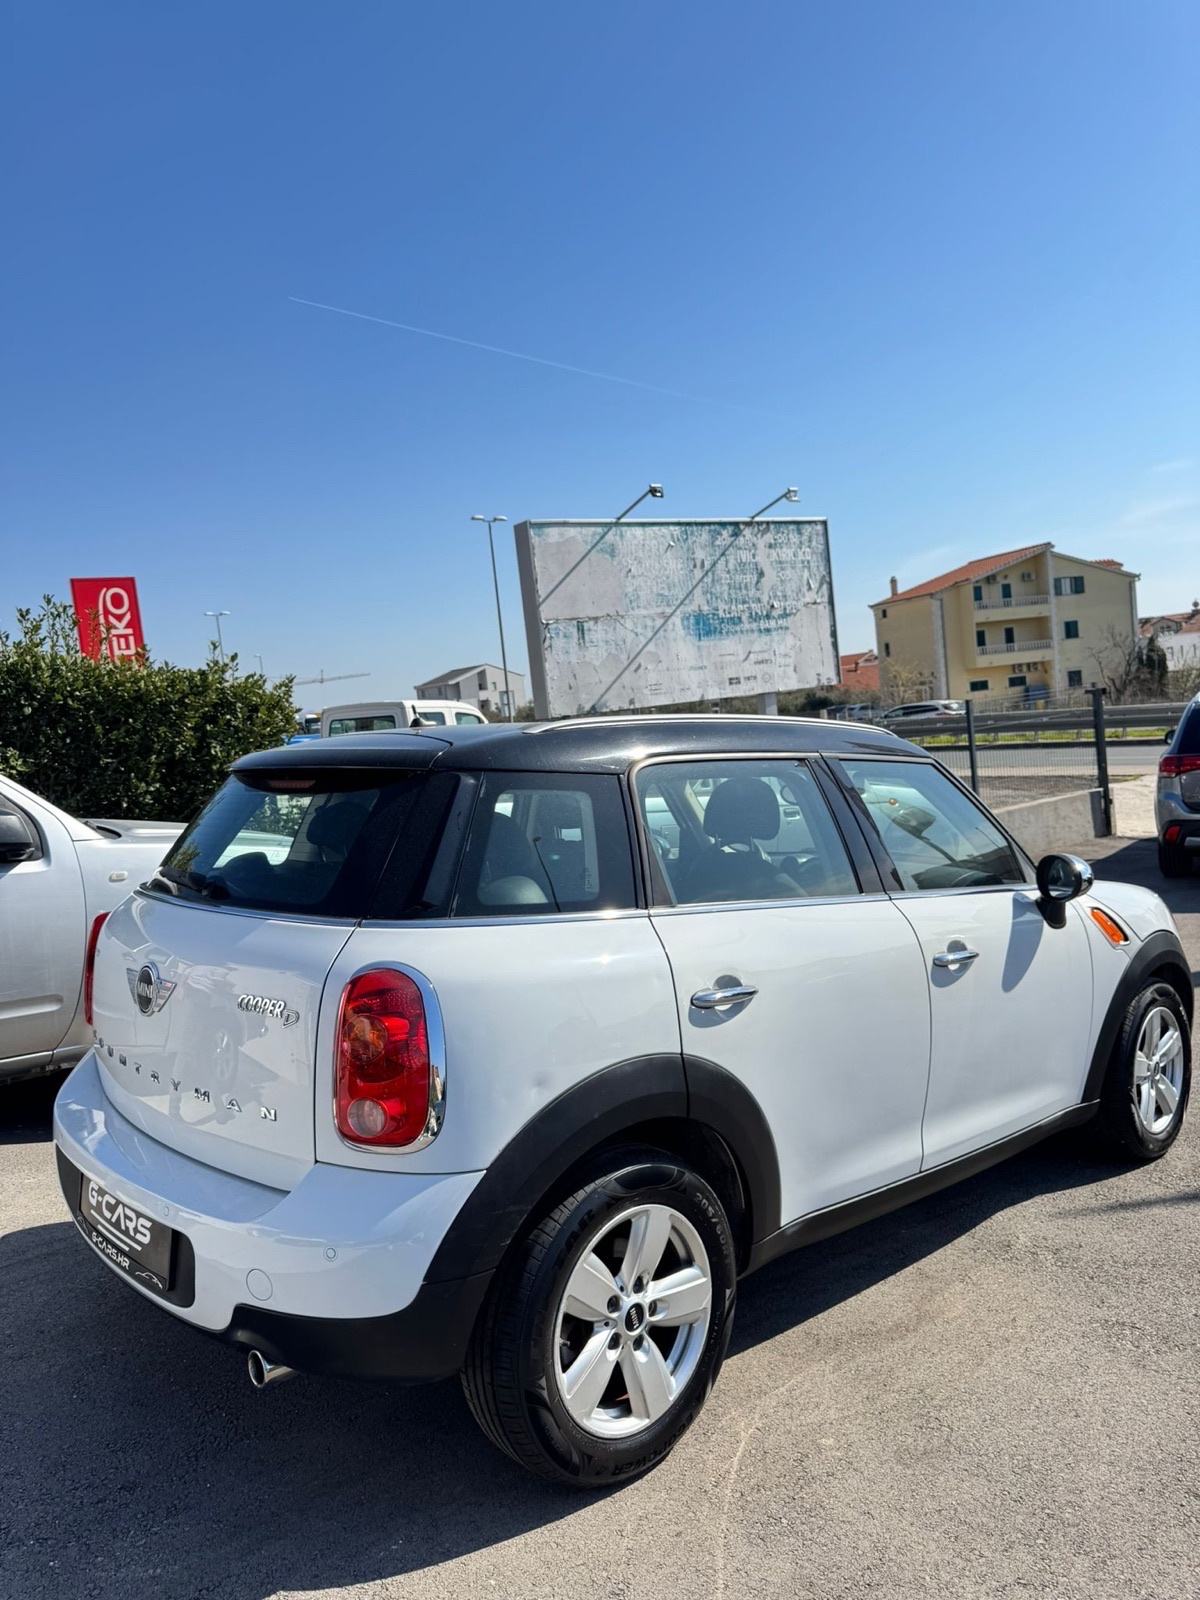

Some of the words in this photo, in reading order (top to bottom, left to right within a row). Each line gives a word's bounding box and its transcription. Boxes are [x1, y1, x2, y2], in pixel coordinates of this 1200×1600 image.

[105, 587, 136, 655] EKO
[136, 980, 153, 998] MINI
[237, 993, 286, 1019] COOPER
[282, 1008, 300, 1029] D
[88, 1180, 153, 1245] G-CARS
[91, 1231, 131, 1271] G-CARS.HR
